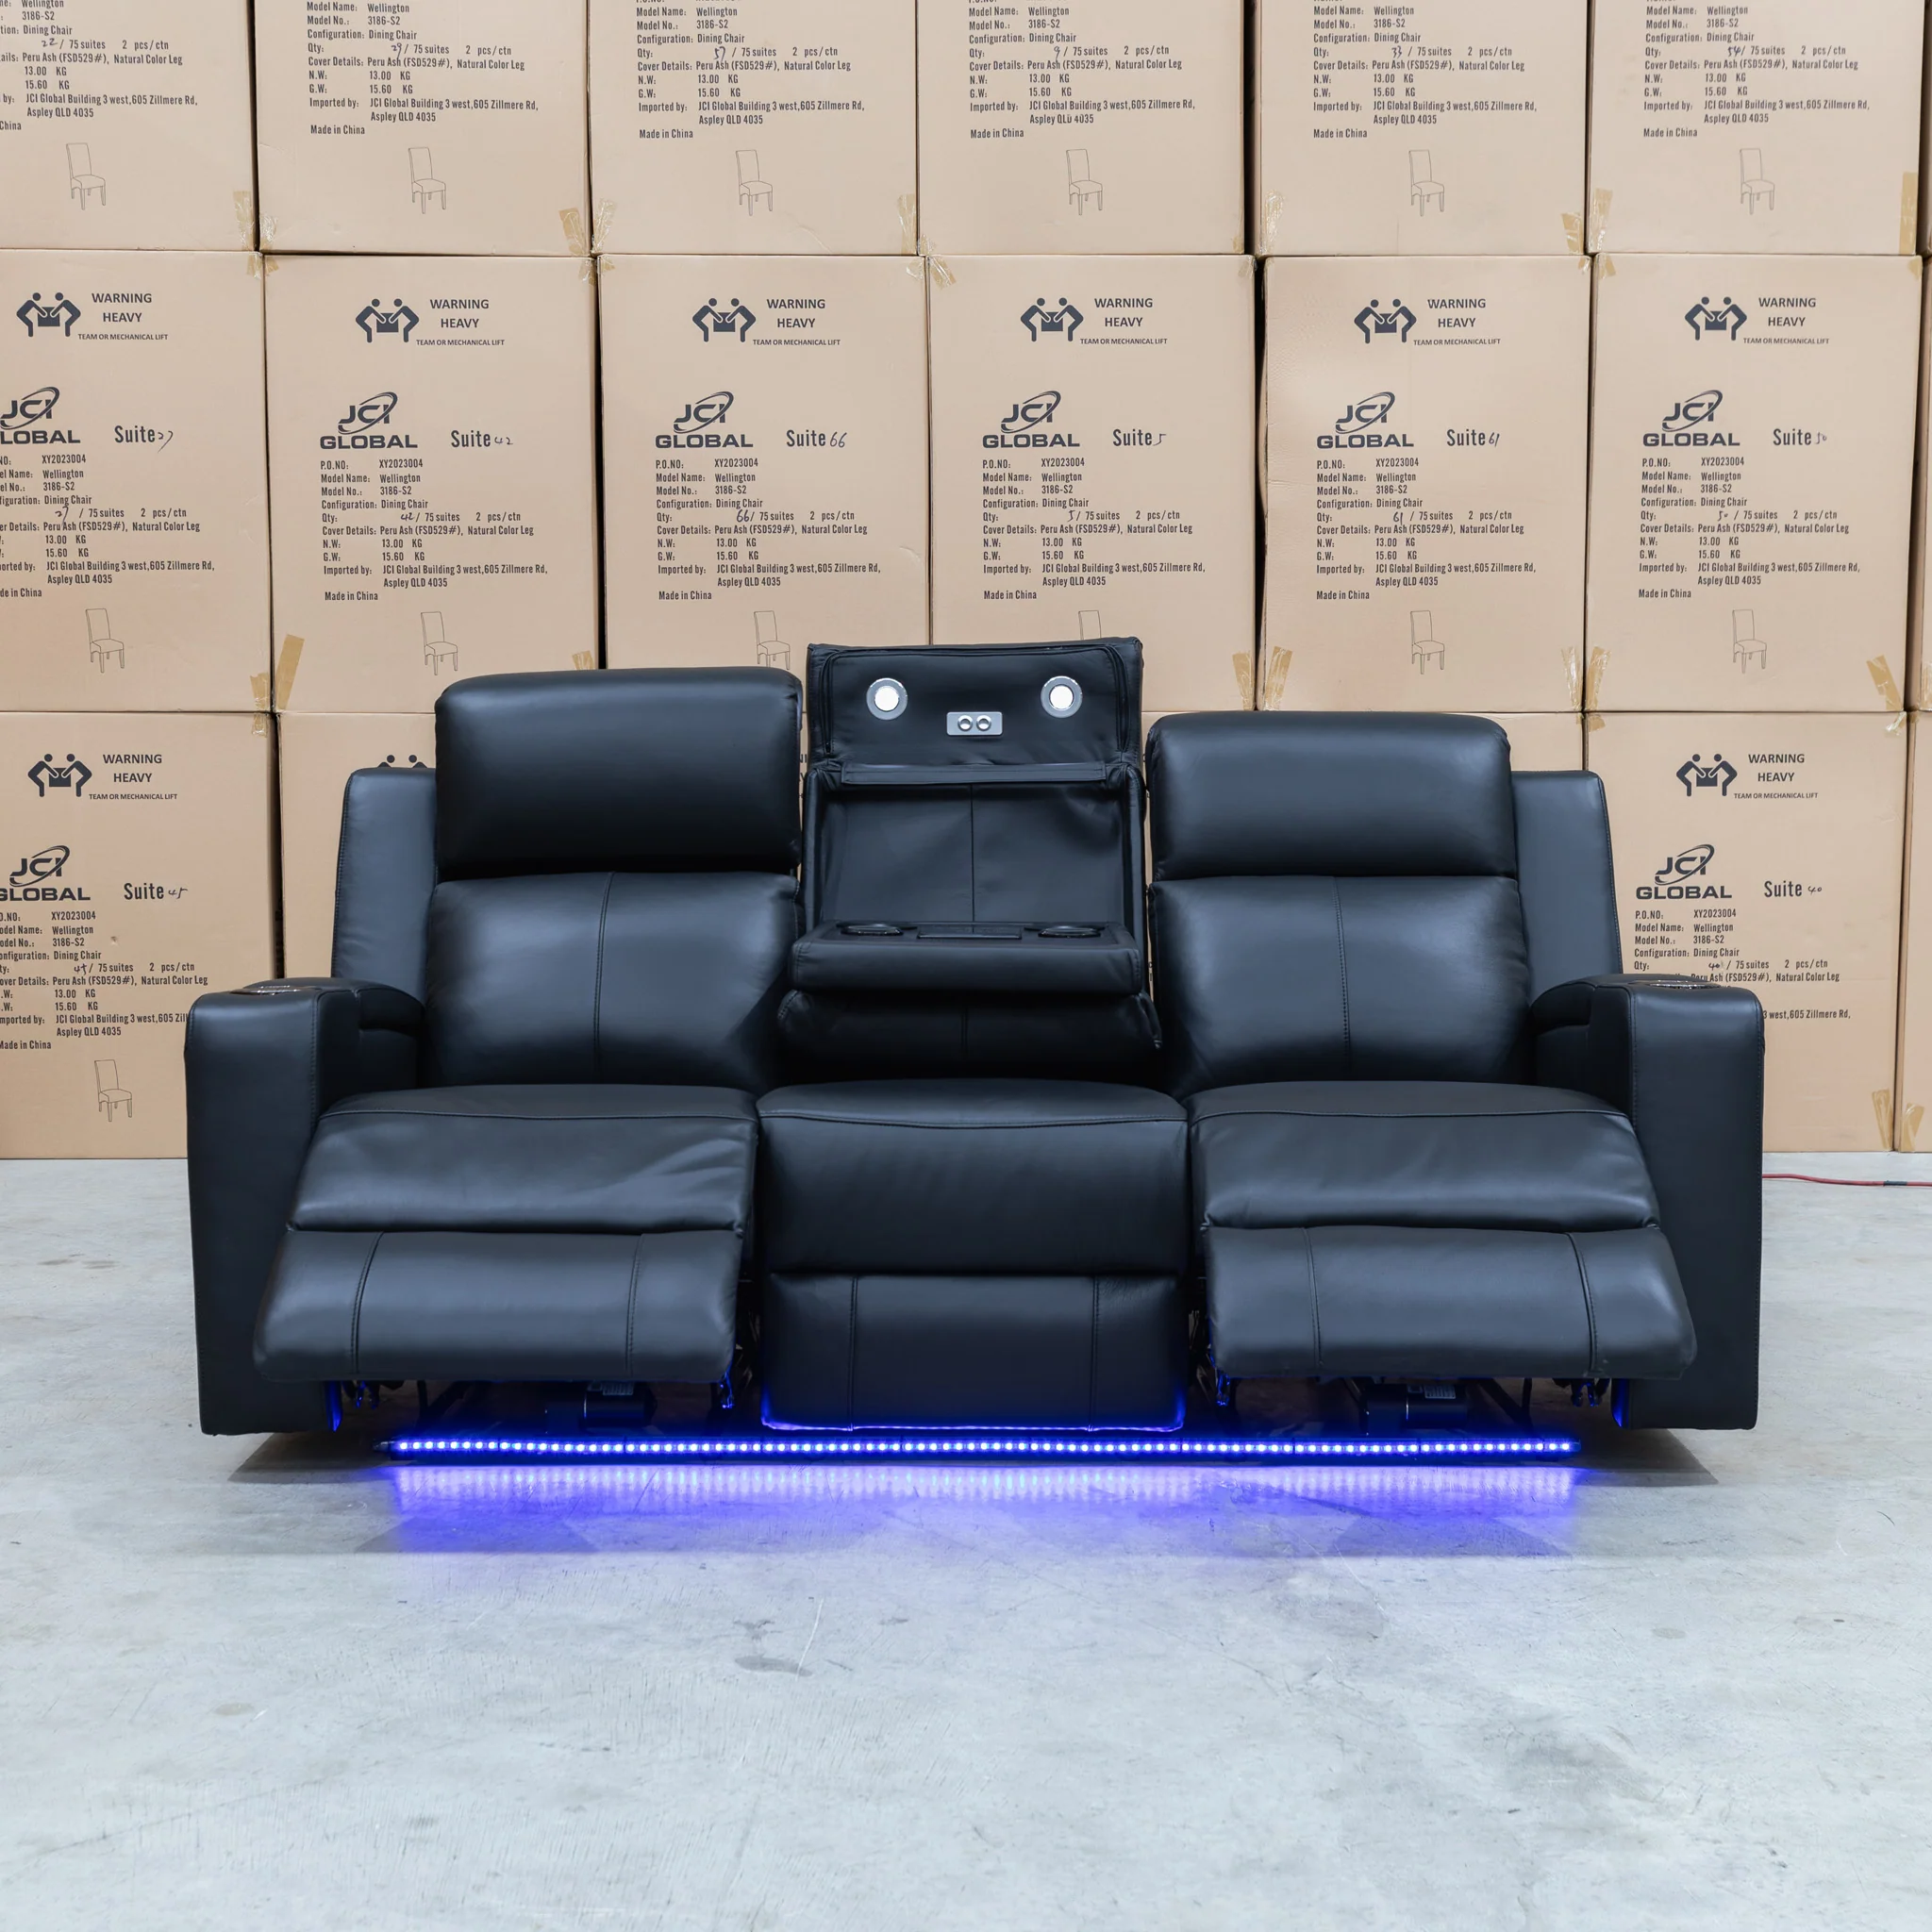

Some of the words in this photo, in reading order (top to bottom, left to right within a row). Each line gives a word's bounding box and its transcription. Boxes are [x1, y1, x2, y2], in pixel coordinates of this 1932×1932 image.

[307, 1, 331, 11] Model
[332, 1, 358, 12] Name:
[367, 3, 410, 15] Wellington
[969, 20, 992, 31] Model
[1028, 18, 1060, 29] 3186-S2
[637, 33, 693, 46] Configuration:
[697, 33, 723, 45] Dining
[724, 32, 745, 43] Chair
[1313, 59, 1336, 71] Cover
[1337, 59, 1369, 71] Details:
[1372, 59, 1390, 70] Peru
[1391, 59, 1406, 70] Ash
[1407, 59, 1455, 72] (FSD529#),
[1458, 60, 1488, 71] Natural
[1489, 59, 1510, 71] Color
[1511, 60, 1525, 73] Leg
[1029, 73, 1051, 84] 13.00
[1058, 73, 1070, 84] KG
[1705, 86, 1727, 96] 15.60
[1737, 85, 1748, 96] KG
[25, 92, 39, 104] JCI
[40, 92, 66, 104] Global
[67, 93, 102, 107] Building
[102, 93, 108, 105] 3
[149, 94, 183, 106] Zillmere
[184, 94, 198, 106] Rd,
[698, 114, 724, 126] Aspley
[725, 114, 741, 125] QLD
[742, 114, 763, 125] 4035
[310, 124, 332, 135] Made
[333, 125, 341, 135] in
[342, 125, 365, 135] China
[1643, 127, 1664, 138] Made
[1666, 127, 1674, 138] in
[1675, 127, 1698, 138] China
[91, 292, 153, 304] WARNING
[429, 298, 490, 309] WARNING
[766, 298, 825, 309] WARNING
[1093, 297, 1153, 308] WARNING
[1426, 298, 1487, 309] WARNING
[1757, 297, 1817, 308] WARNING
[102, 311, 142, 323] HEAVY
[441, 318, 480, 328] HEAVY
[776, 317, 816, 328] HEAVY
[1105, 316, 1143, 327] HEAVY
[1438, 317, 1476, 328] HEAVY
[1768, 316, 1807, 327] HEAVY
[0, 429, 81, 445] LOBAL
[114, 425, 156, 443] Suite
[450, 429, 491, 448] Suite
[786, 428, 826, 447] Suite
[829, 431, 848, 448] 66
[1112, 428, 1153, 447] Suite
[1446, 428, 1486, 447] Suite
[1488, 431, 1500, 447] 61
[1642, 432, 1740, 447] GLOBAL
[1773, 427, 1812, 446] Suite
[319, 434, 419, 450] GLOBAL
[655, 433, 754, 449] GLOBAL
[982, 433, 1081, 449] GLOBAL
[1316, 433, 1415, 450] GLOBAL
[42, 453, 87, 464] XY2023004
[320, 459, 349, 471] P.O.NO:
[378, 458, 424, 469] XY2023004
[42, 469, 84, 481] Wellington
[982, 472, 1006, 482] Model
[1008, 472, 1032, 482] Name:
[1041, 472, 1083, 484] Wellington
[321, 499, 377, 511] Configuration:
[380, 499, 407, 511] Dining
[407, 498, 429, 509] Chair
[657, 511, 673, 524] Qty:
[736, 508, 750, 524] 66
[758, 511, 769, 522] 75
[770, 510, 794, 522] suites
[809, 510, 815, 521] 2
[1375, 576, 1402, 589] Aspley
[1402, 576, 1417, 587] QLD
[1418, 575, 1439, 587] 4035
[1638, 589, 1659, 599] Made
[1660, 589, 1669, 598] in
[1670, 588, 1691, 598] China
[102, 754, 162, 764] WARNING
[1747, 753, 1806, 764] WARNING
[113, 773, 153, 783] HEAVY
[1757, 772, 1795, 782] HEAVY
[124, 882, 165, 901] Suite
[1635, 885, 1733, 900] GLOBAL
[1763, 879, 1803, 898] Suite
[1635, 909, 1664, 920] P.O.NO:
[1693, 908, 1737, 919] XY2023004
[52, 937, 85, 947] 3186-S2
[55, 1001, 77, 1011] 15.60
[87, 1001, 99, 1011] KG
[1806, 1009, 1838, 1019] Zillmere
[1839, 1008, 1851, 1020] Rd,
